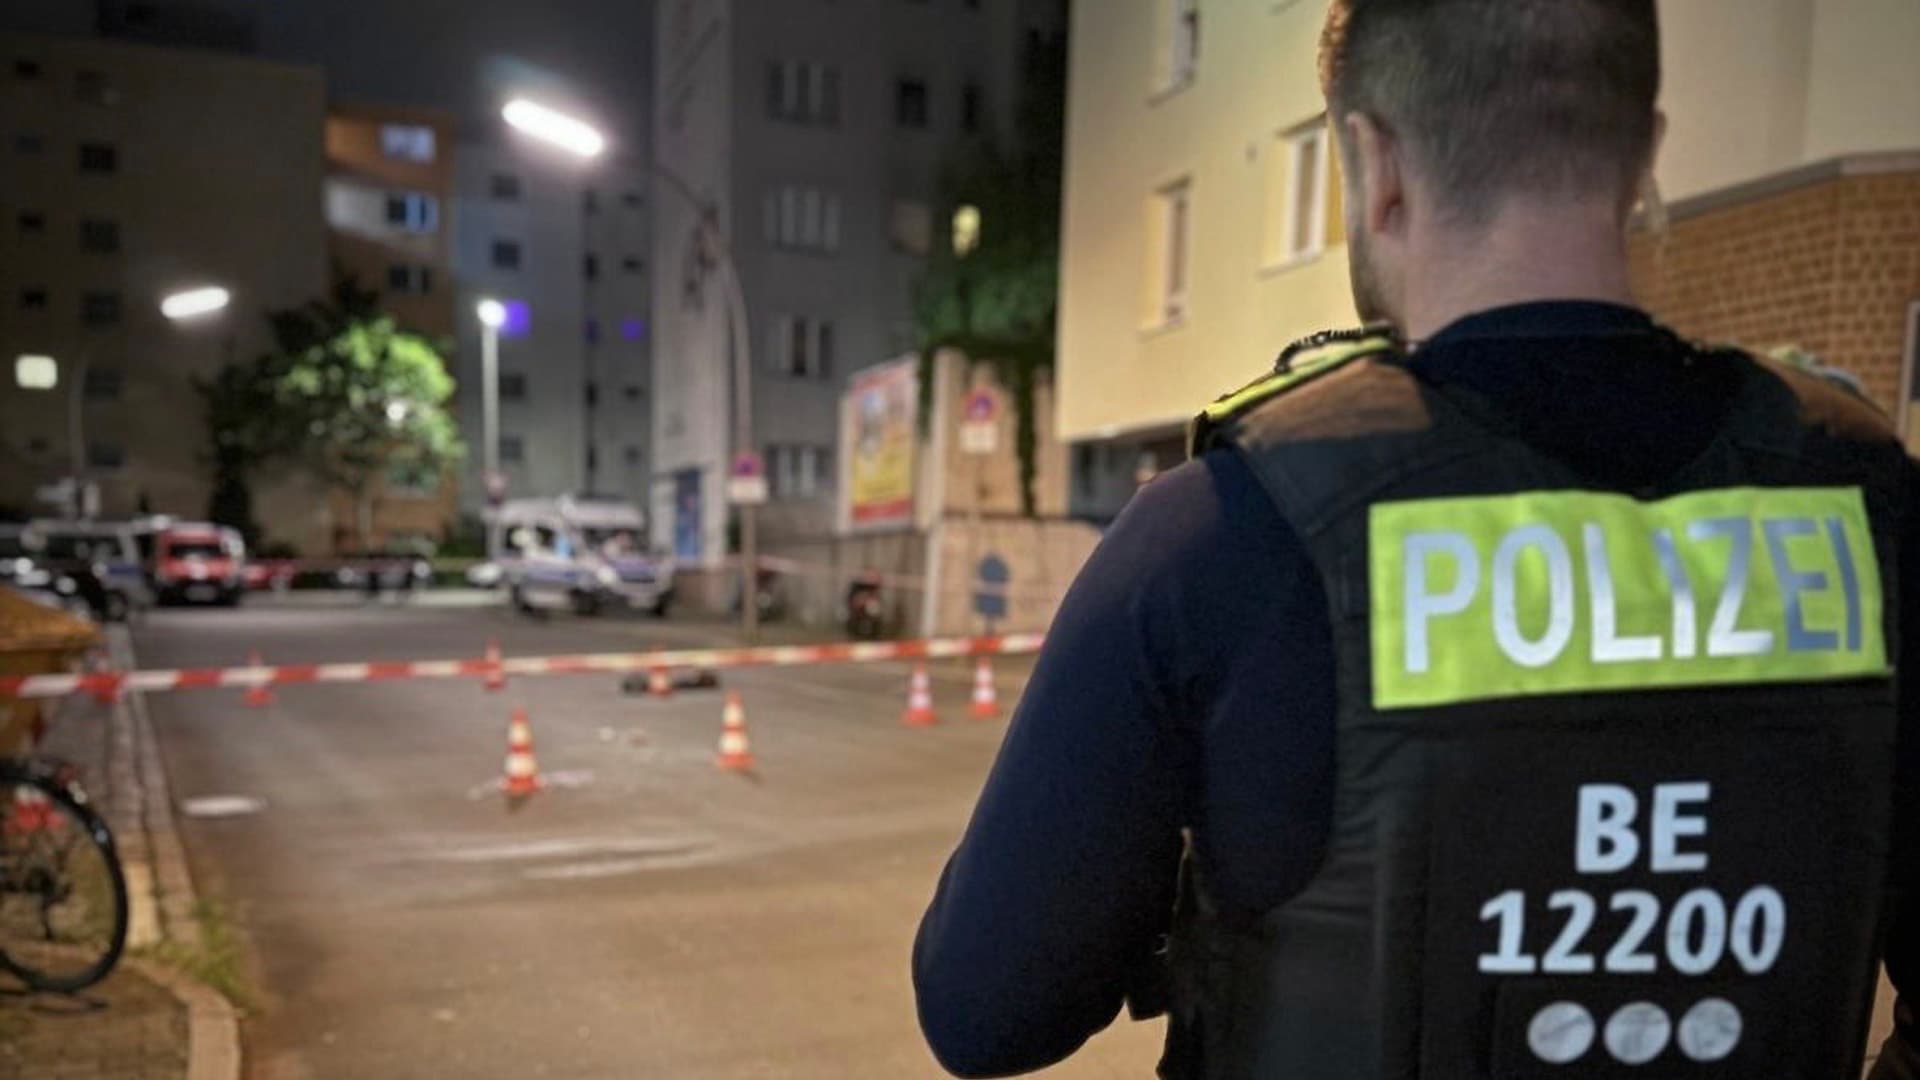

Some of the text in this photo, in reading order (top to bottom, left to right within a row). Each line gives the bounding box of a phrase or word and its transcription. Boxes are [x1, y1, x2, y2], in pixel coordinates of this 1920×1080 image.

[1403, 515, 1863, 674] POLIZEI
[1575, 781, 1711, 874] BE
[1477, 885, 1786, 976] 12200
